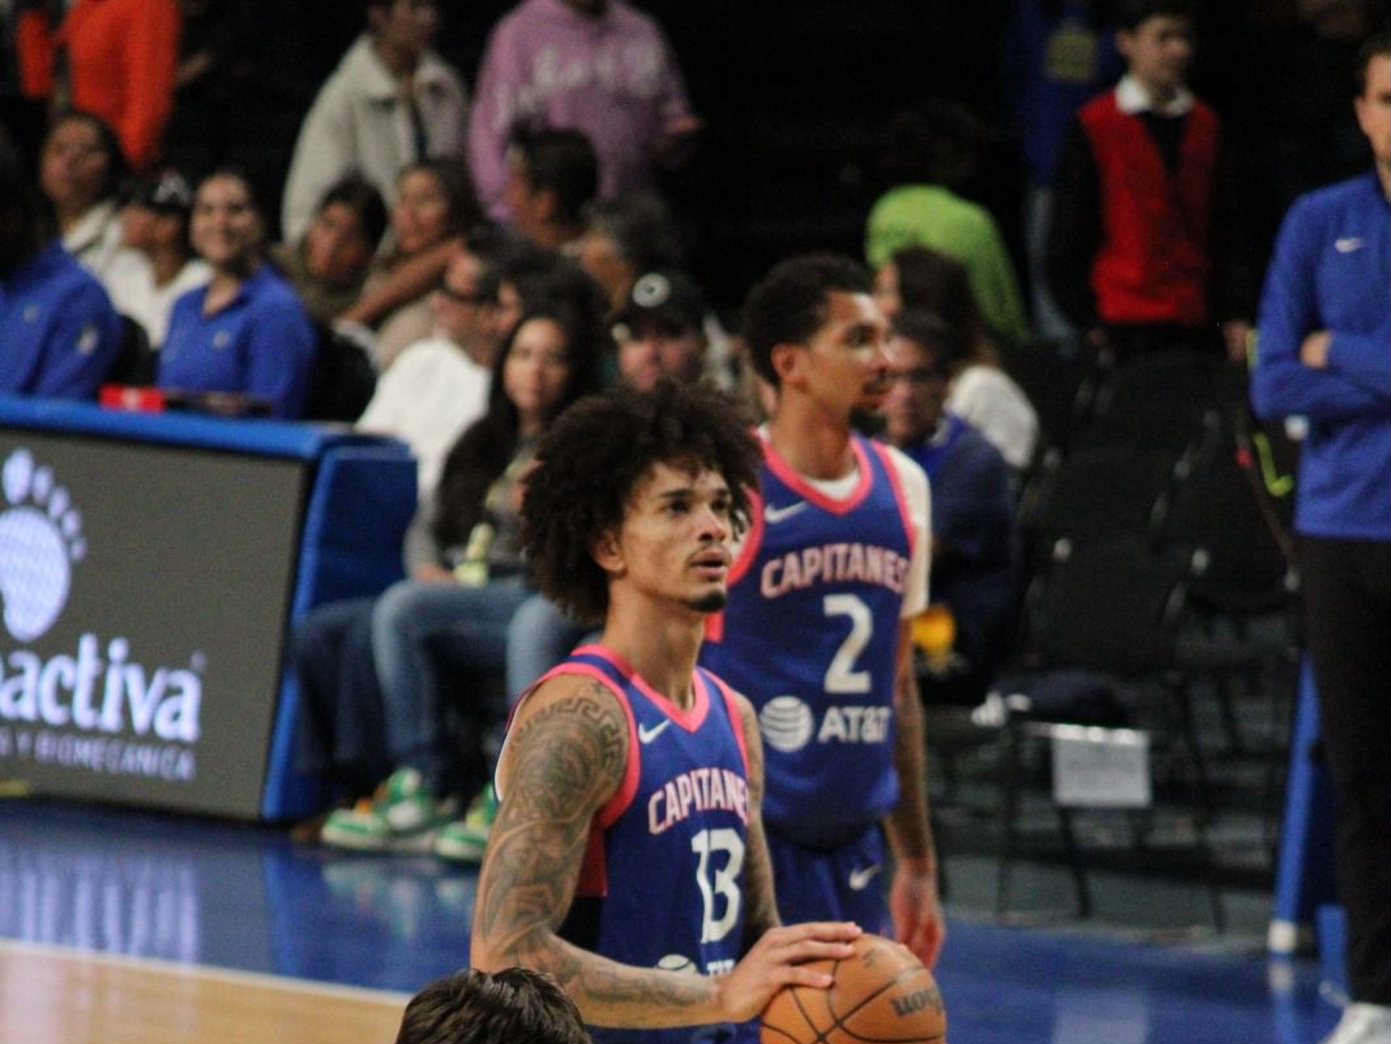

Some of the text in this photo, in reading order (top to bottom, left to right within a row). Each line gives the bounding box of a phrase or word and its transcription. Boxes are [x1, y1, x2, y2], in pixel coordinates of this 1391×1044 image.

[760, 542, 909, 598] CAPITANES
[824, 593, 873, 694] 2
[0, 632, 202, 744] activa
[817, 706, 891, 744] AT&T
[648, 767, 751, 835] CAPITANE
[691, 828, 745, 945] 13
